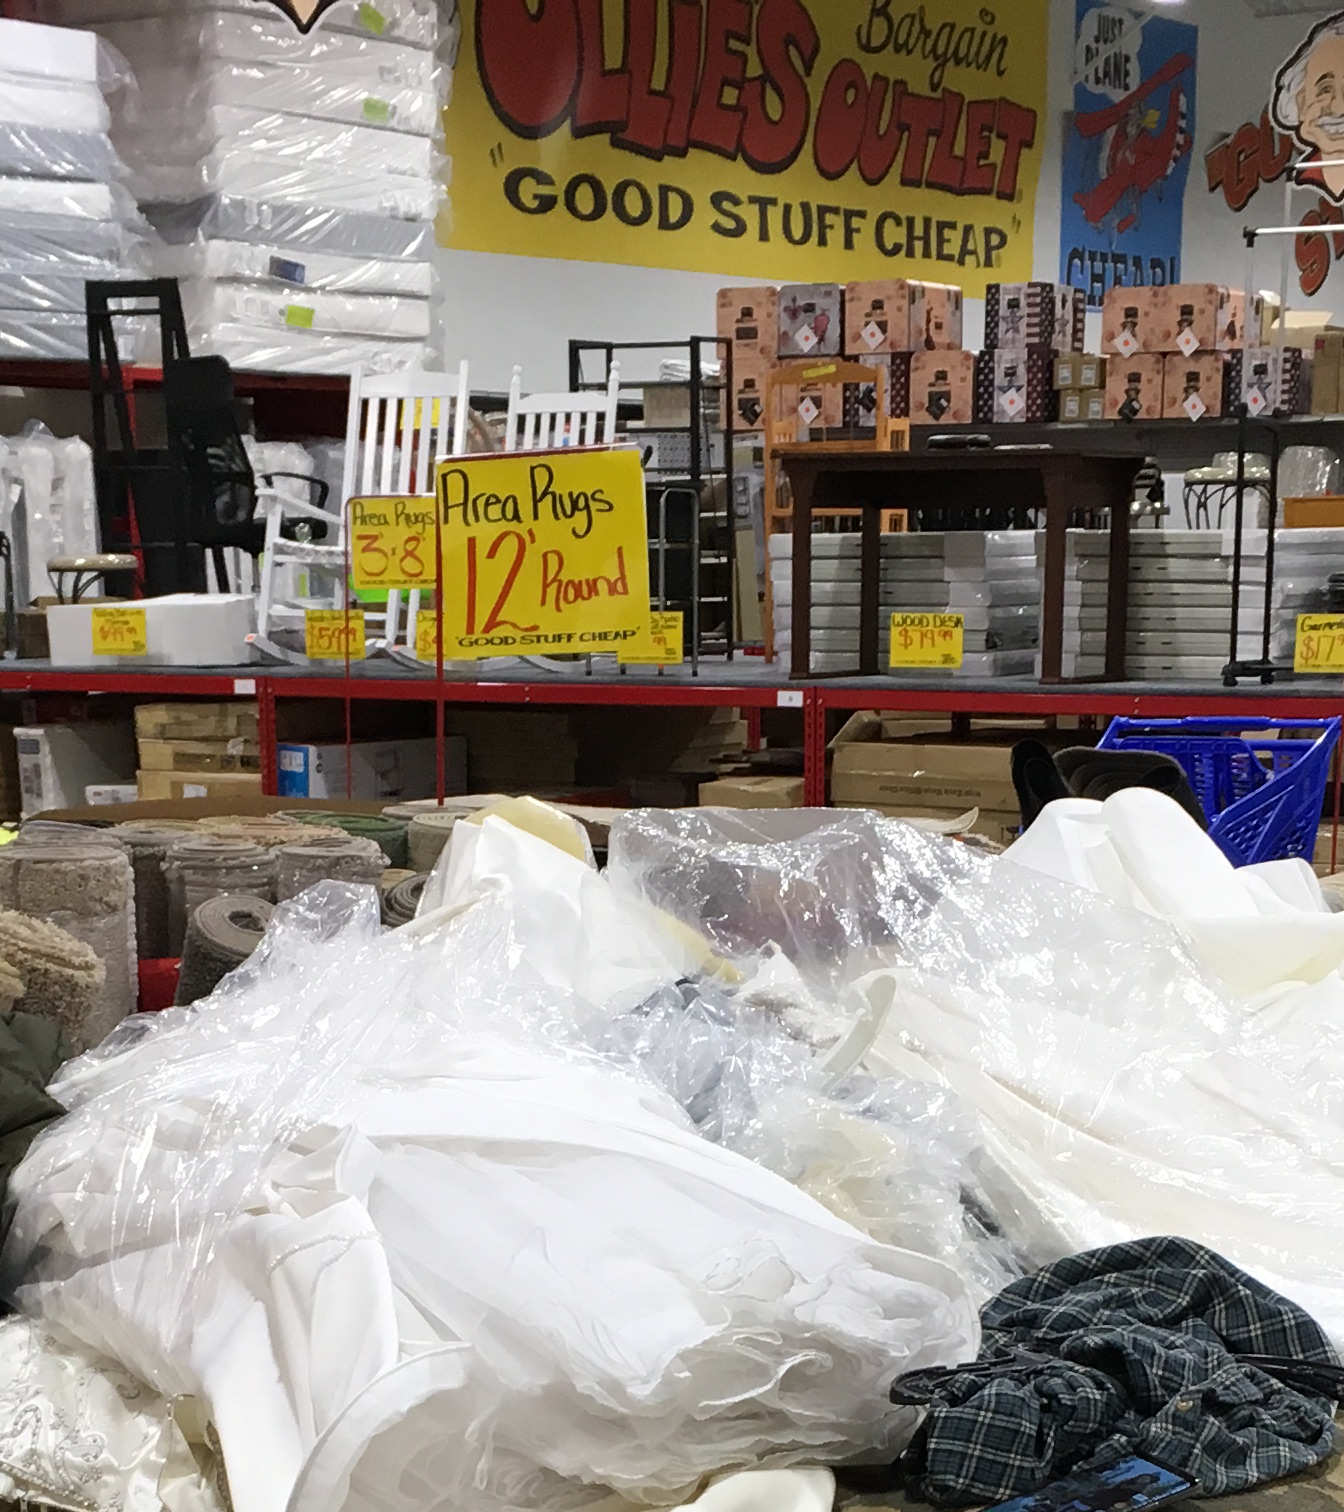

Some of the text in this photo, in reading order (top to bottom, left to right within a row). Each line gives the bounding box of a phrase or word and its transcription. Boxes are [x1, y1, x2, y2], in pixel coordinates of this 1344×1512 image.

[856, 0, 1009, 93] Bargain
[1094, 13, 1125, 46] JUST
[813, 57, 1038, 202] OUTLET
[710, 190, 867, 251] STUFF
[352, 501, 435, 534] Area Rugs
[441, 463, 614, 539] Area Rugs
[540, 546, 629, 613] Round
[520, 633, 578, 645] STUFF
[892, 614, 963, 629] WOOD DESK
